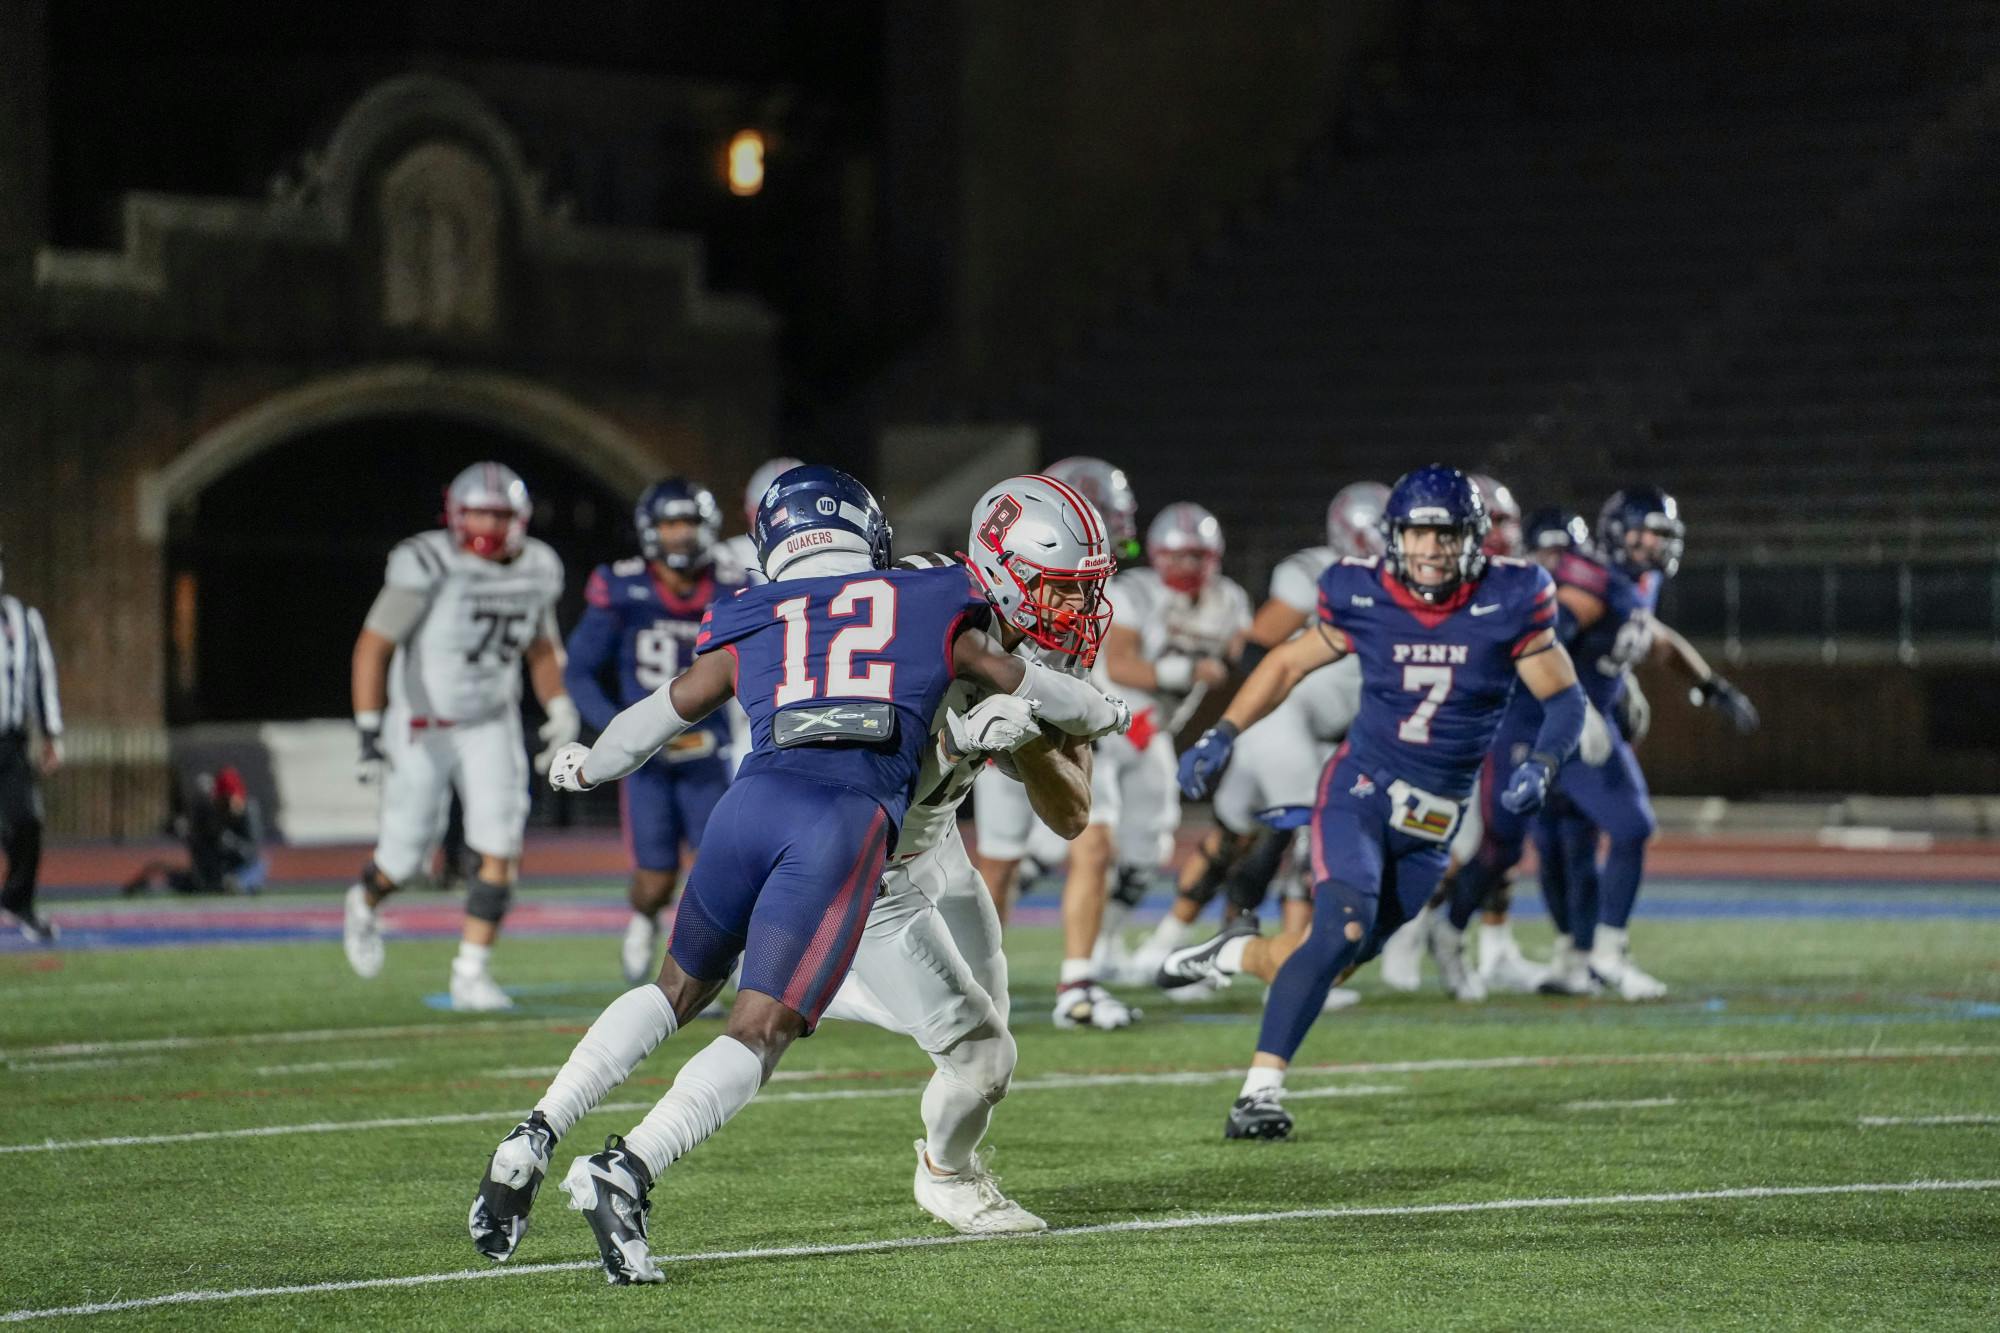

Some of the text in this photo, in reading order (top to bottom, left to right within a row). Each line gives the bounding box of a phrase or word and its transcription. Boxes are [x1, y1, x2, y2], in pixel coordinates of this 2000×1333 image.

[819, 500, 834, 512] VD
[786, 531, 833, 553] QUAKERS
[467, 610, 527, 664] 75
[774, 577, 897, 707] 12
[1393, 644, 1468, 664] PENN
[1398, 665, 1453, 744] 7
